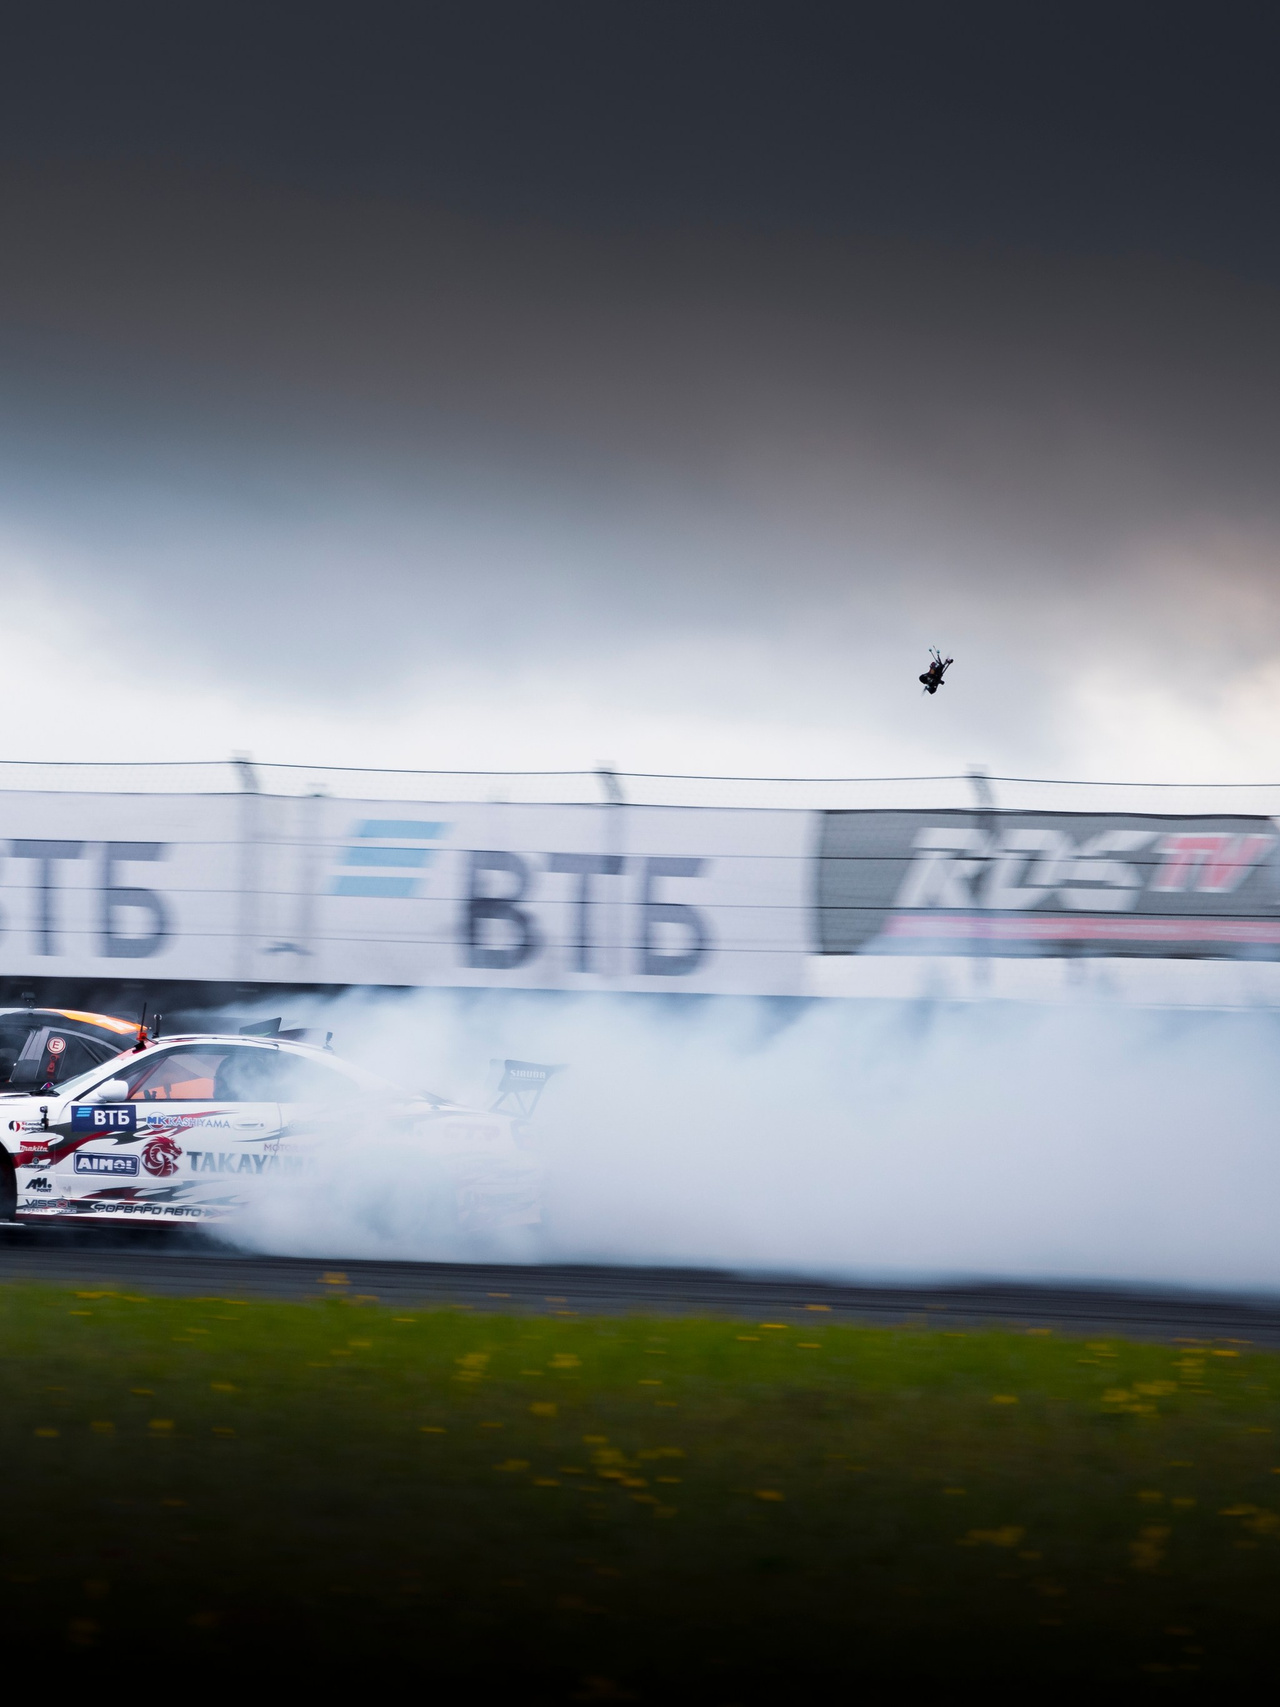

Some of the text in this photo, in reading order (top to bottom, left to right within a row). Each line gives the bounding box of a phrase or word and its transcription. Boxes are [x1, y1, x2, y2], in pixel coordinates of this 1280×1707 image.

[459, 850, 716, 977] ВТБ
[52, 1040, 60, 1049] E
[94, 1109, 130, 1126] ВТБ
[146, 1116, 231, 1129] MK KASHIYAMA
[77, 1157, 136, 1172] AIMOL
